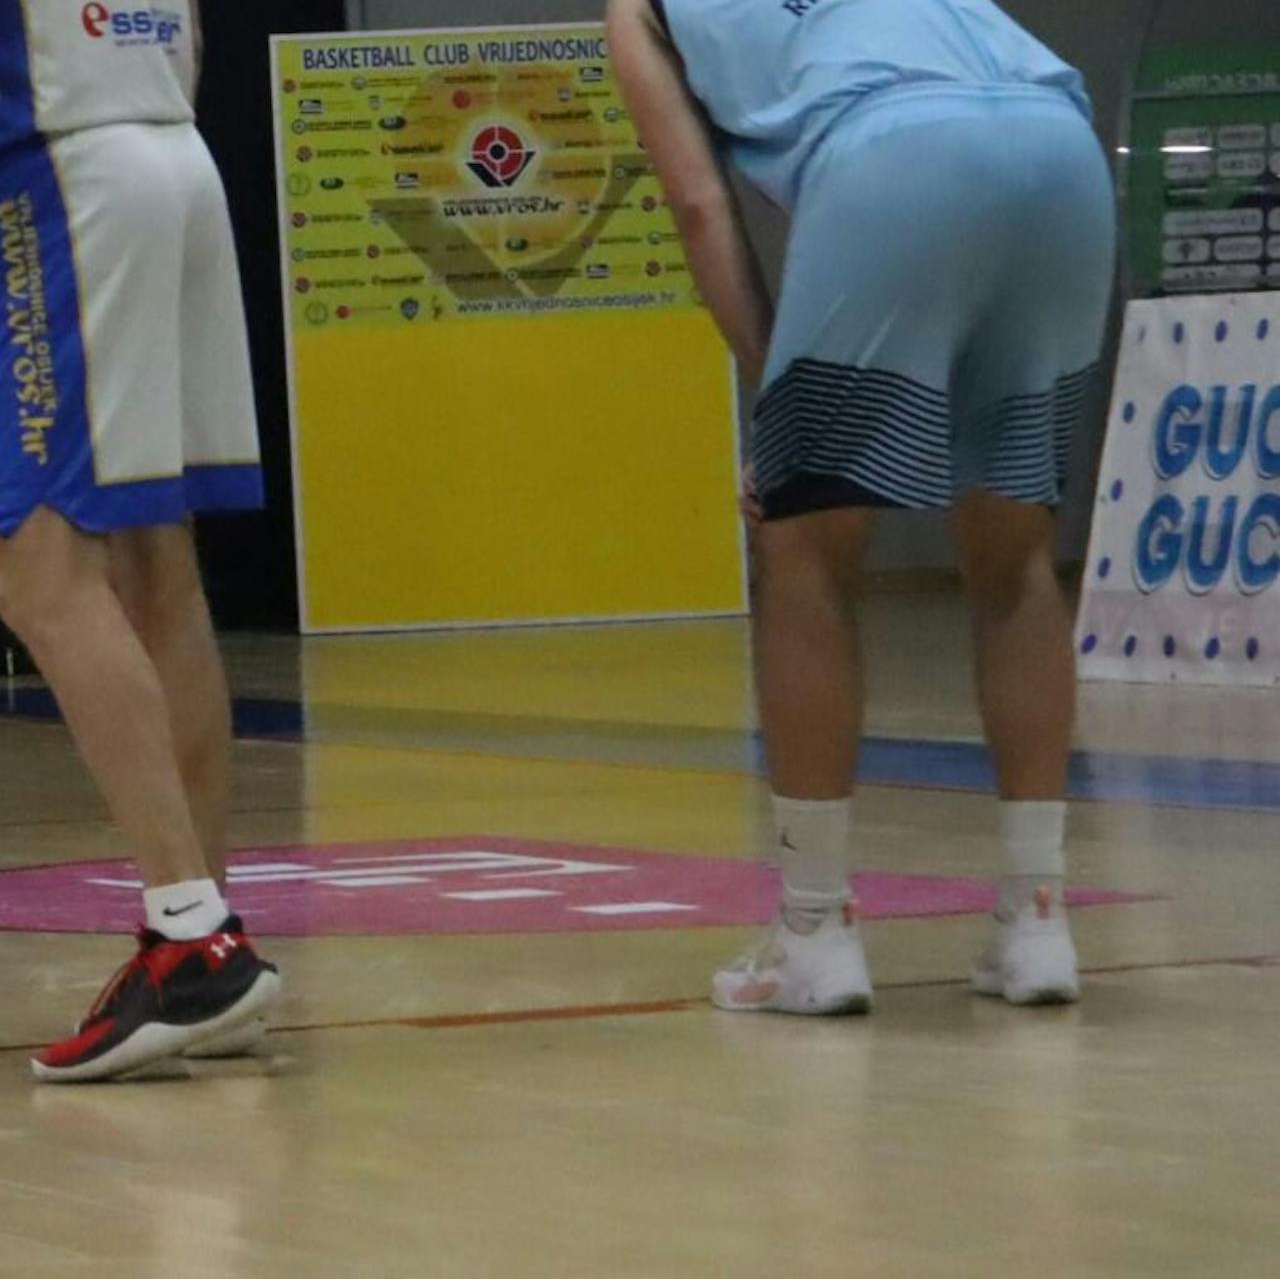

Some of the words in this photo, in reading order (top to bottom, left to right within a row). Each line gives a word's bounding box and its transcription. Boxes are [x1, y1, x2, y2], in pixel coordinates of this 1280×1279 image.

[303, 45, 416, 71] BASKETBALL
[423, 43, 470, 66] CLUB
[477, 38, 608, 64] VRIJEDNOSNIC
